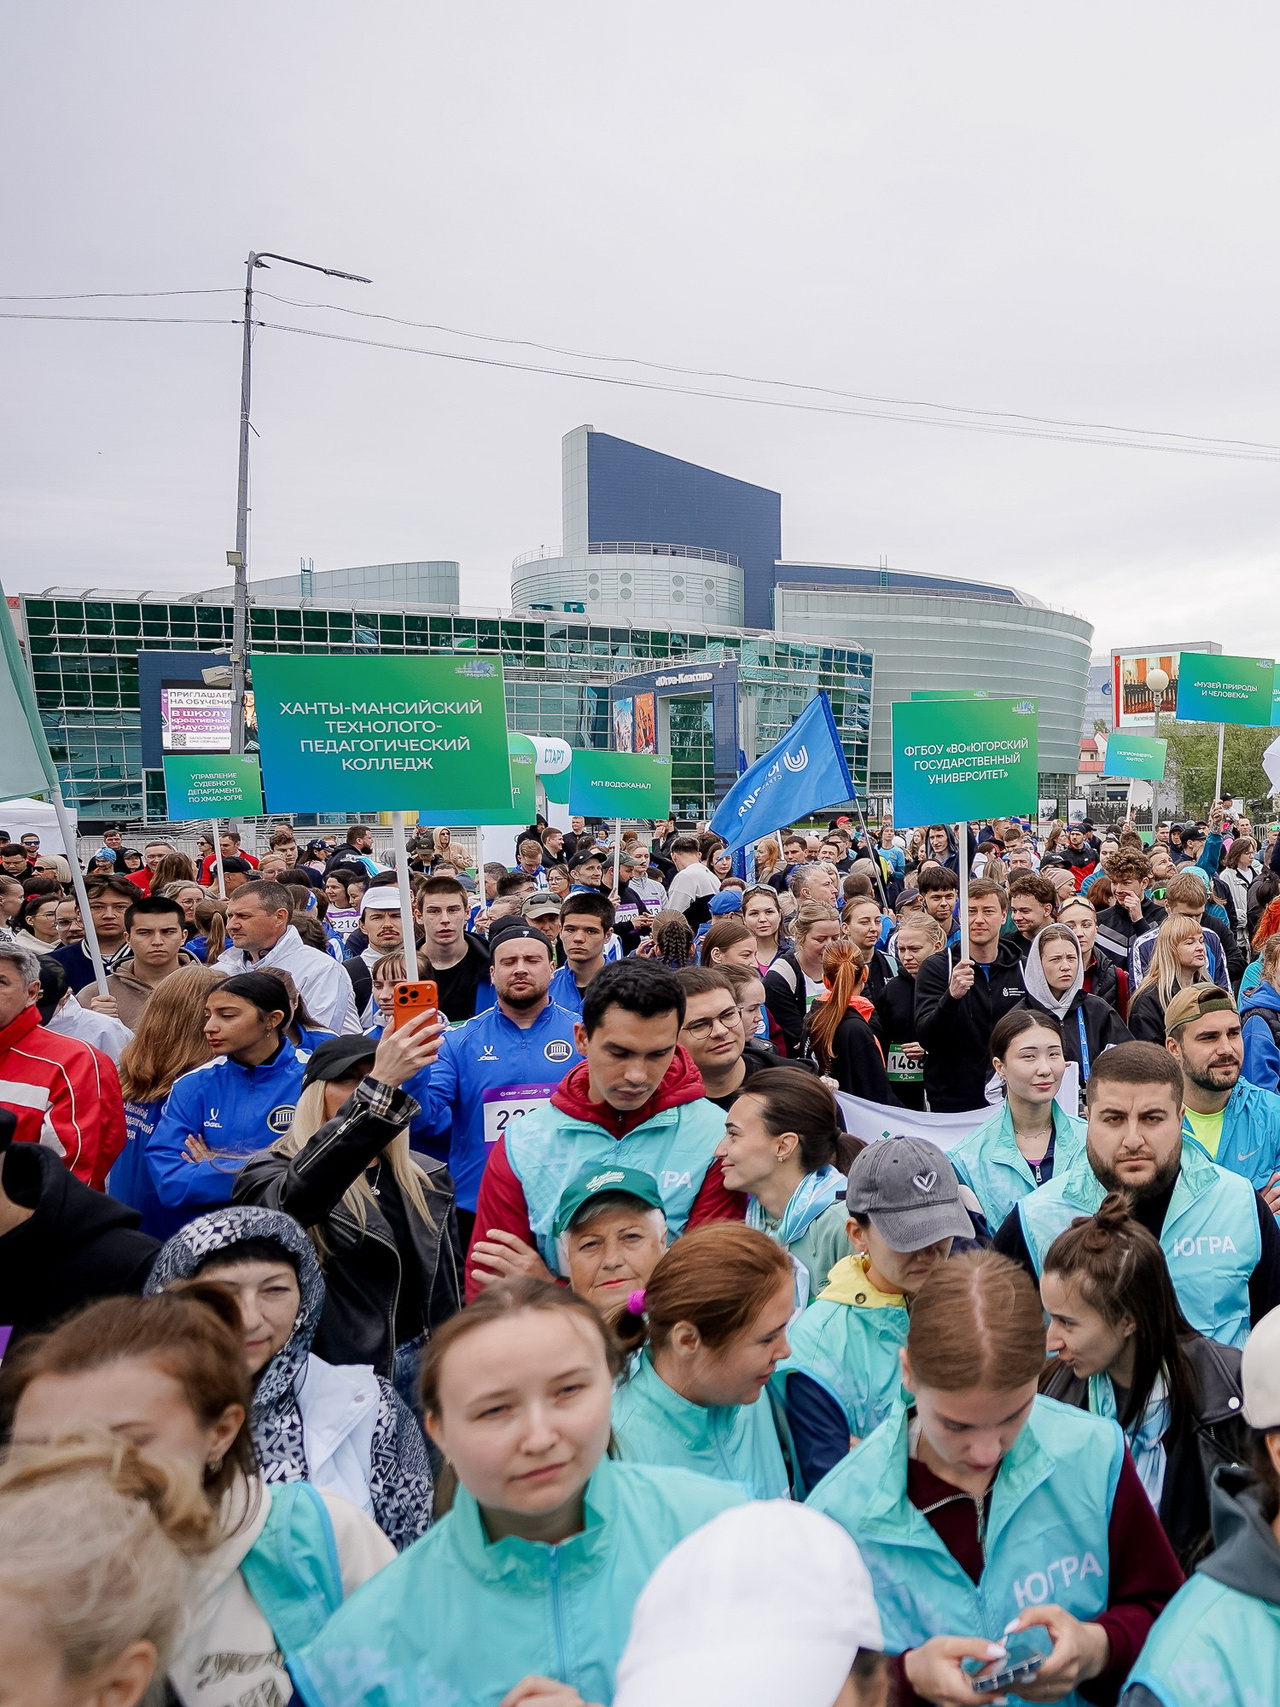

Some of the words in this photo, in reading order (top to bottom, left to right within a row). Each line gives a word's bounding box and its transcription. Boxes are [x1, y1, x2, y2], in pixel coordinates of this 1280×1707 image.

[1194, 681, 1221, 689] «МУЗЕЙ
[1222, 683, 1258, 692] ПРИРОДЫ
[1208, 690, 1249, 699] ЧЕЛОВЕКА»
[279, 699, 483, 715] ХАНТЫ-МАНСИЙСКИЙ
[171, 724, 230, 732] индустрий
[325, 720, 442, 734] ТЕХНОЛОГО-
[300, 736, 471, 754] ПЕДАГОГИЧЕСКИЙ
[904, 744, 944, 757] ФГБОУ
[544, 748, 565, 764] СТАРТ
[914, 752, 1021, 771] ГОСУДАРСТВЕННЫЙ
[341, 757, 434, 772] КОЛЛЕДЖ
[928, 768, 1009, 784] УНИВЕРСИТЕТ»
[193, 780, 235, 788] СУДЕБНОГО
[605, 780, 651, 790] ВОДОКАНАЛ
[187, 787, 243, 796] ДЕПАРТАМЕНТА
[200, 795, 243, 803] ХМАО-ЮГРЕ
[331, 920, 358, 929] 2216
[1174, 1235, 1238, 1257] ЮГРА
[1013, 1551, 1104, 1610] ЮГРА
